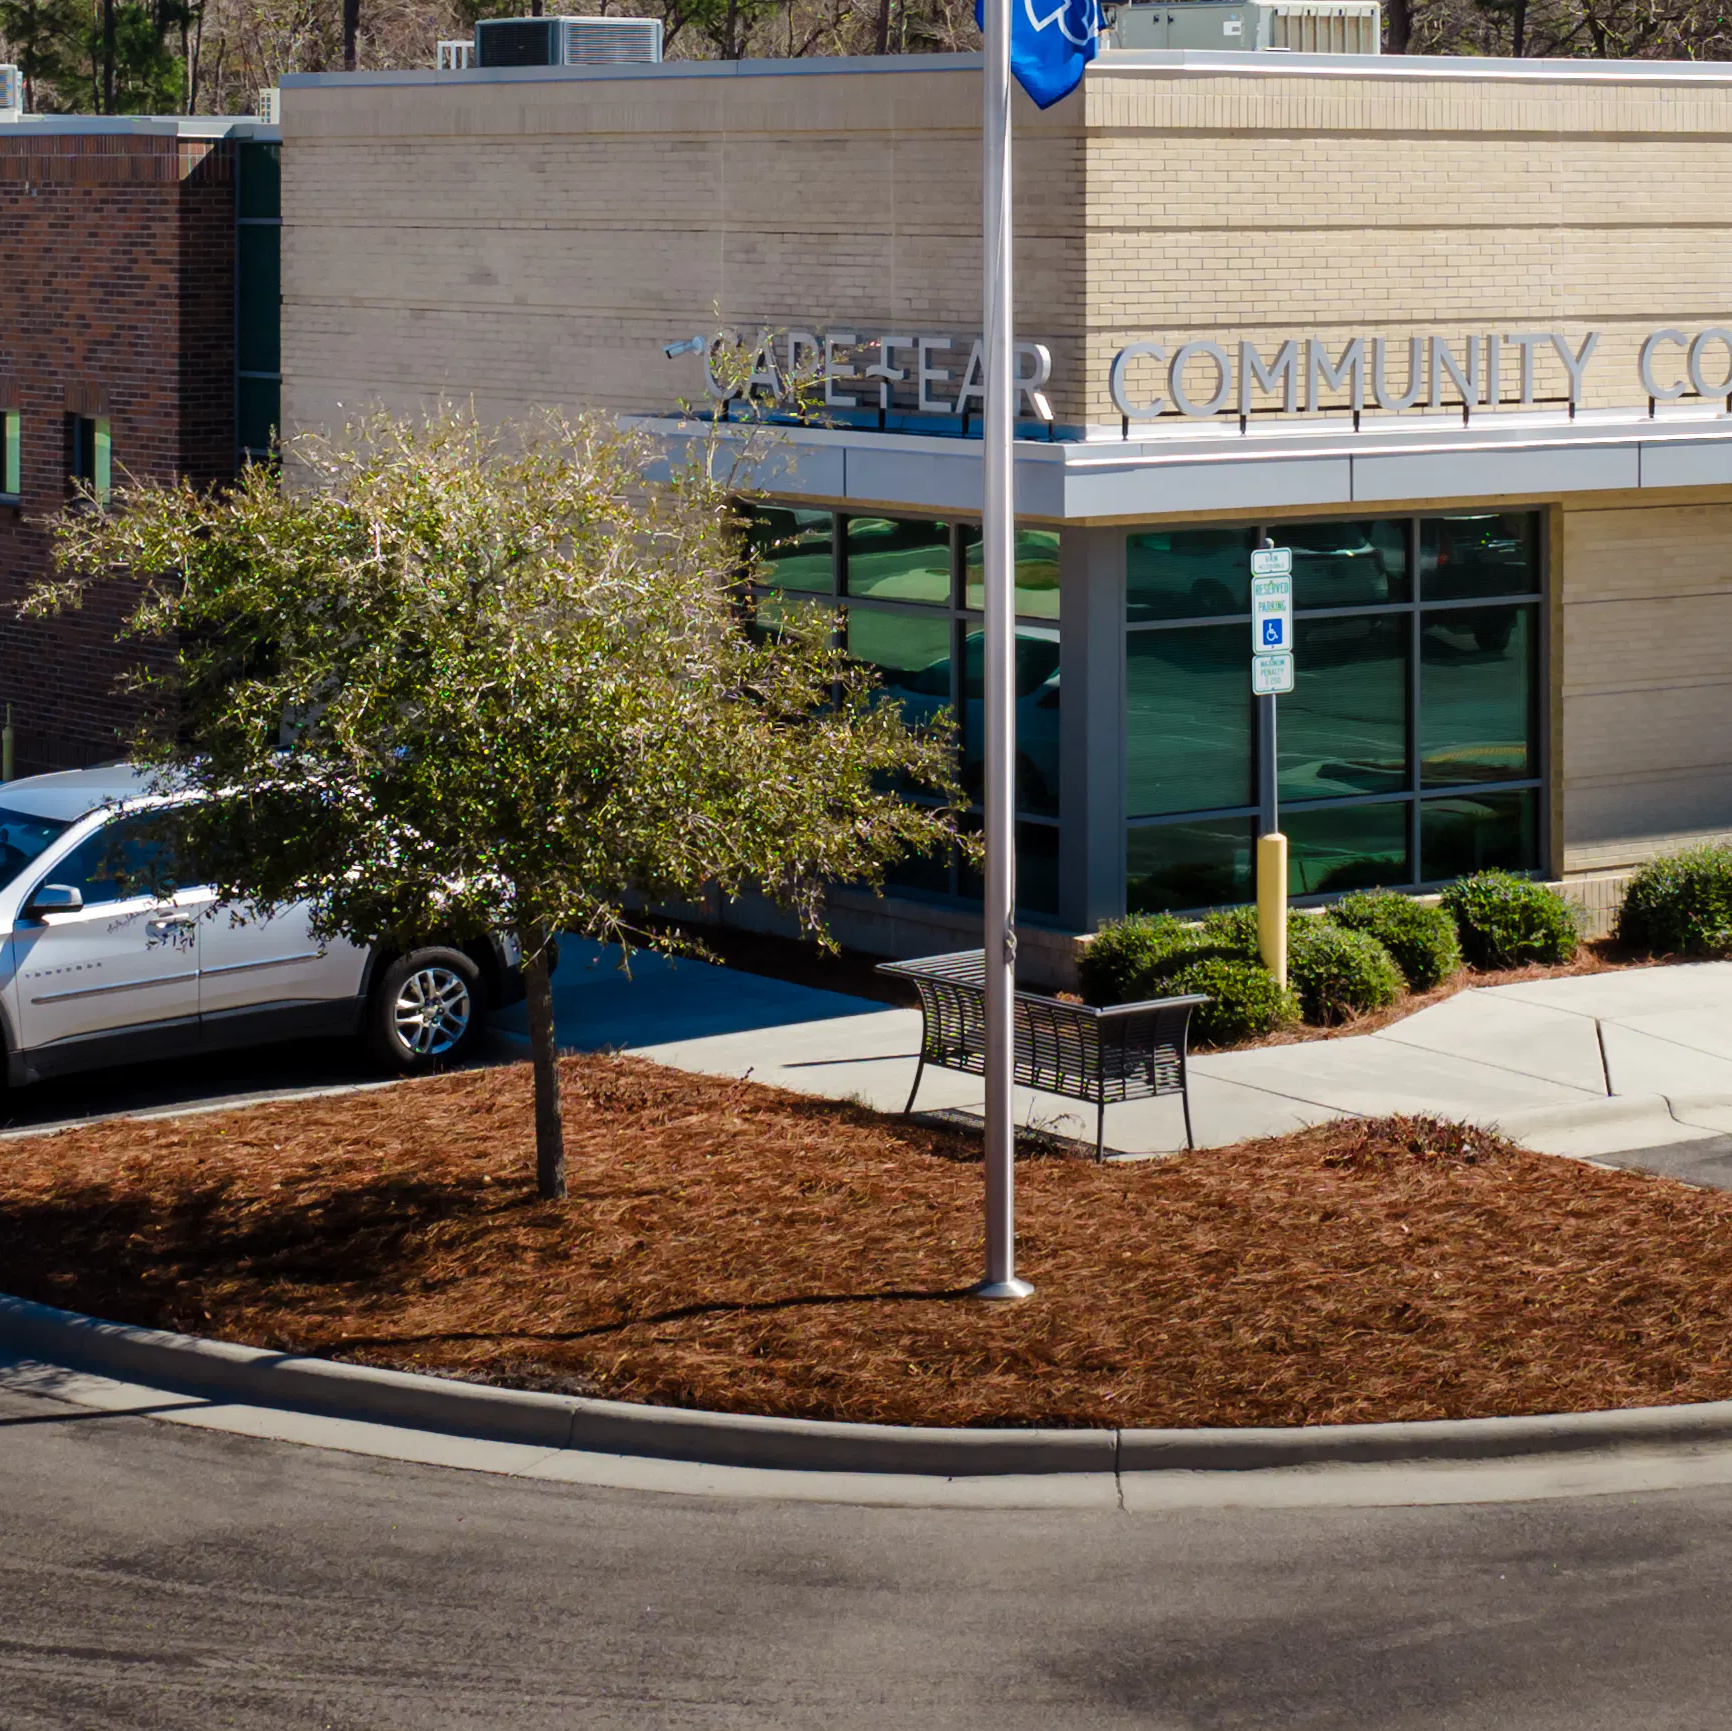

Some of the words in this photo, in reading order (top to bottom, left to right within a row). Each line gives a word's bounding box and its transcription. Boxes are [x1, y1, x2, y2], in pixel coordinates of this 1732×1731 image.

[703, 327, 861, 408] CAPE
[879, 336, 1054, 421] FEAR
[1111, 331, 1602, 420] COMMUNITY
[1255, 582, 1289, 596] RESERVED
[1258, 600, 1287, 613] PARKING
